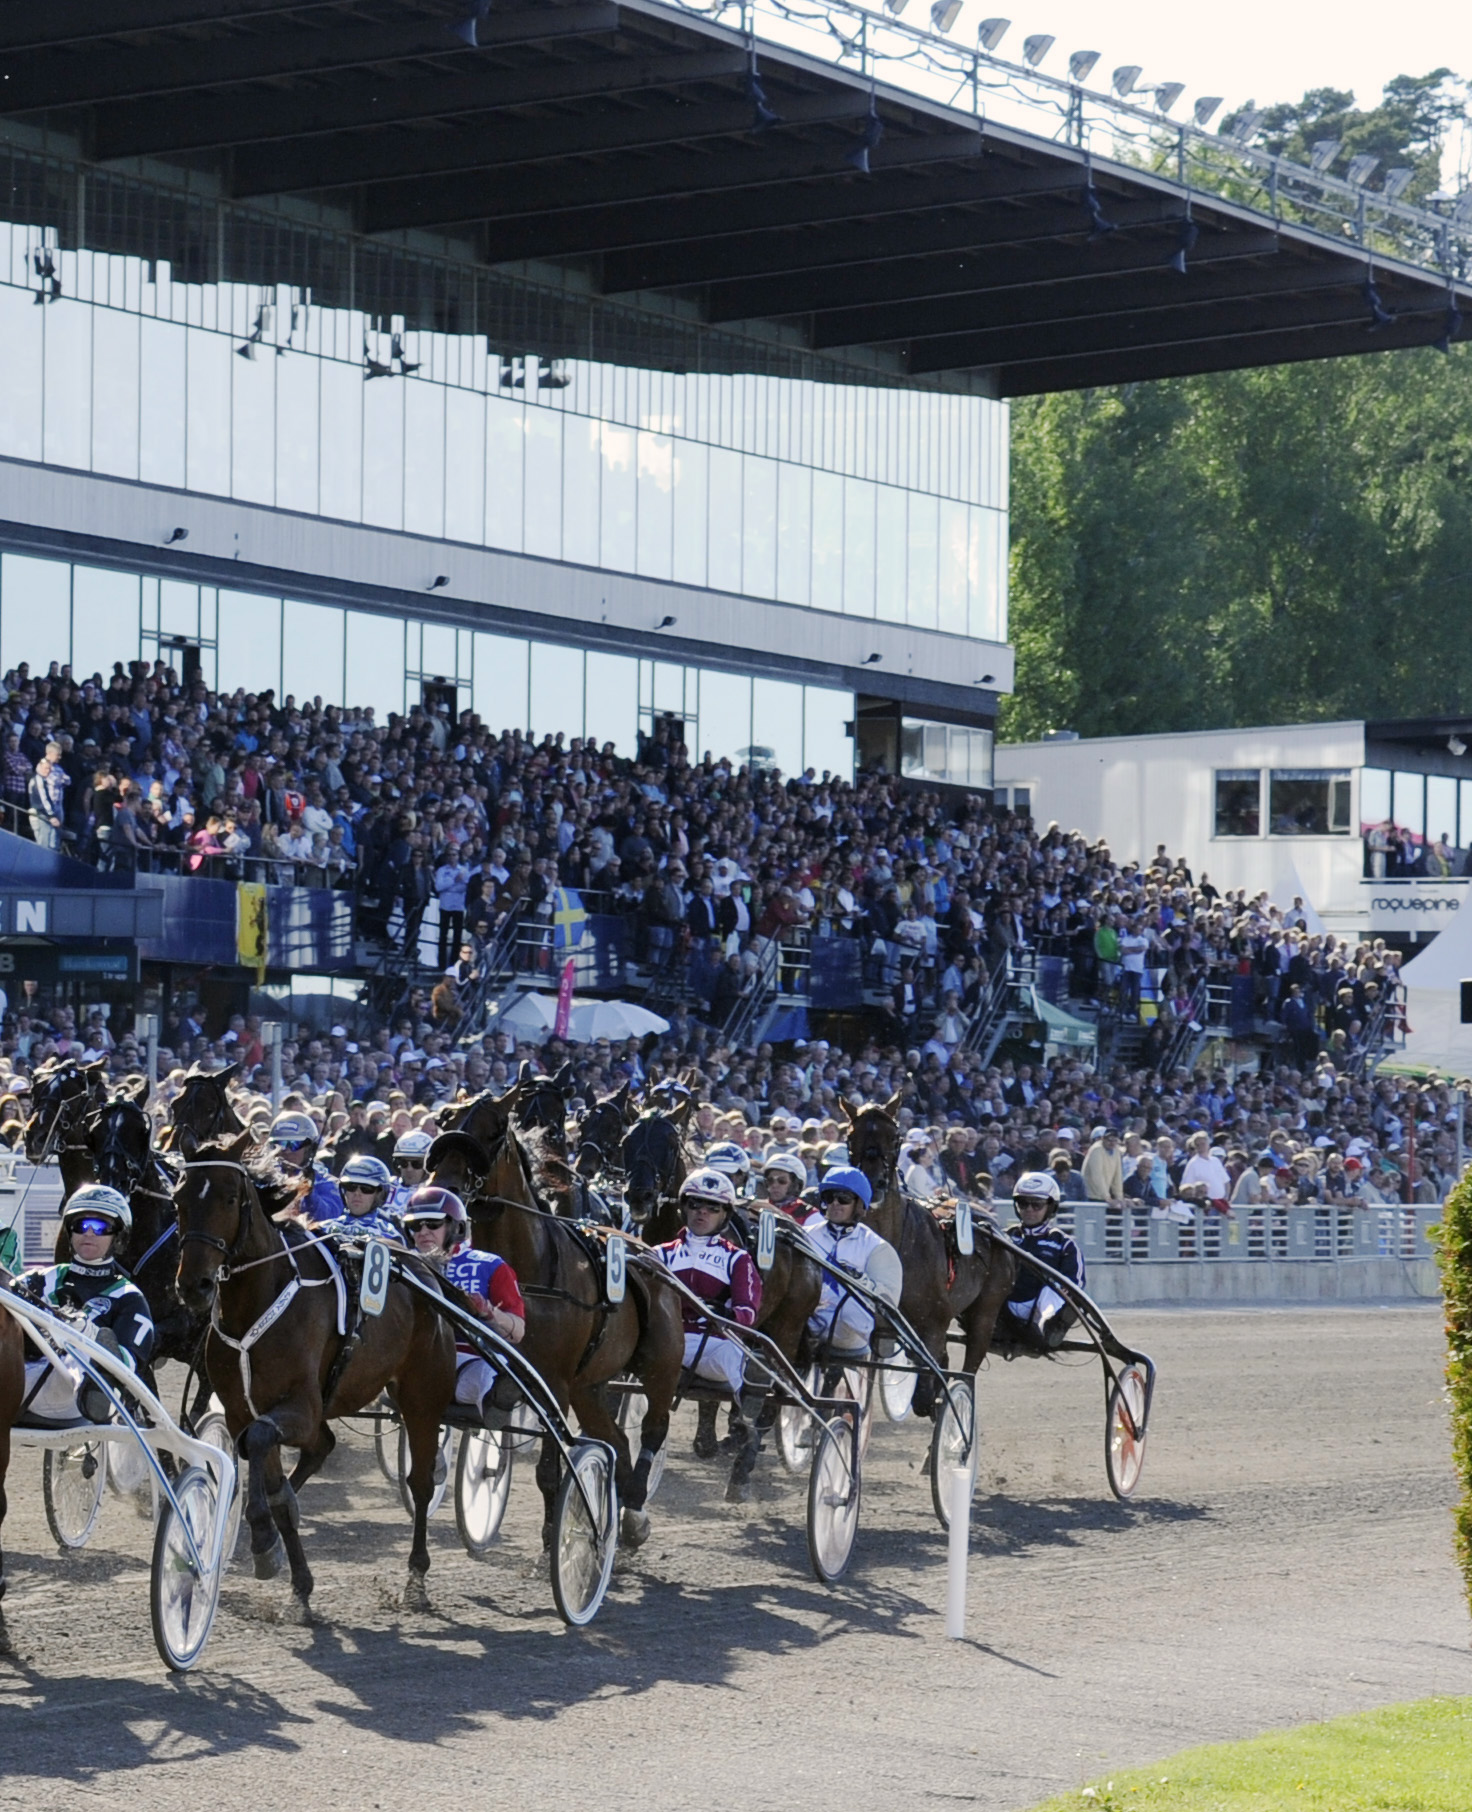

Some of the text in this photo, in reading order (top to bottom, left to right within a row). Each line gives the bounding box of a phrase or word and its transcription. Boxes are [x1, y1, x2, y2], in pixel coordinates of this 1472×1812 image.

[1371, 898, 1460, 913] roquepine
[760, 1213, 774, 1254] 10
[958, 1203, 967, 1238] 7
[368, 1244, 385, 1295] 8
[611, 1239, 622, 1284] 5
